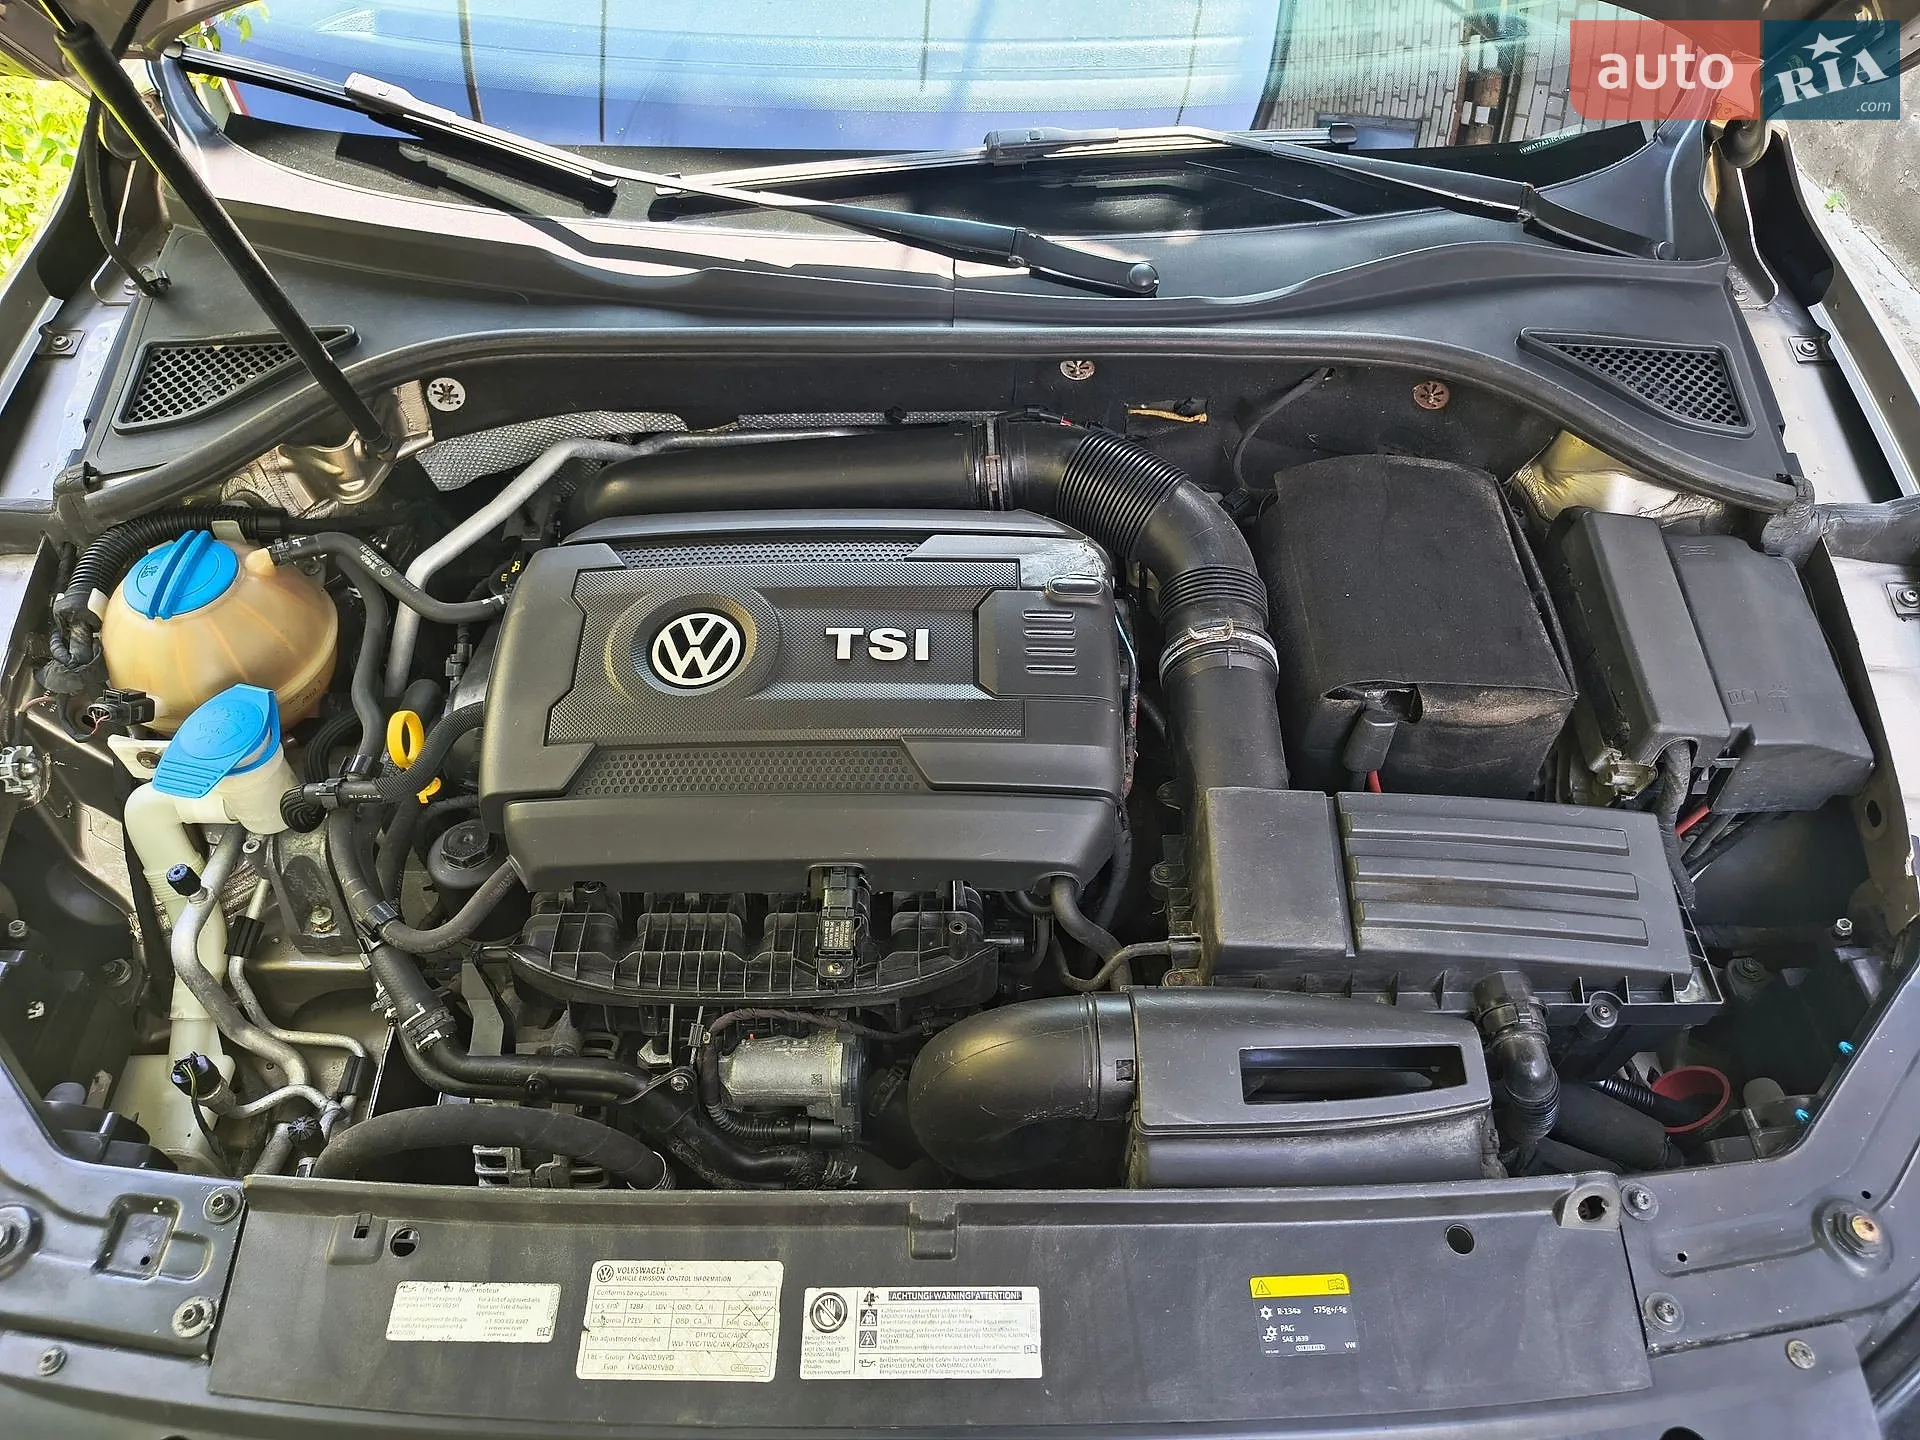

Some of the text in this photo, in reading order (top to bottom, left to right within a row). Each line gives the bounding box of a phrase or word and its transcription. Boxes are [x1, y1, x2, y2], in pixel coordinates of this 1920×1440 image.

[825, 627, 930, 661] TSI
[617, 1266, 666, 1275] VOLKSWAGEN
[1280, 1324, 1295, 1332] PAG
[1281, 1335, 1295, 1343] SAE
